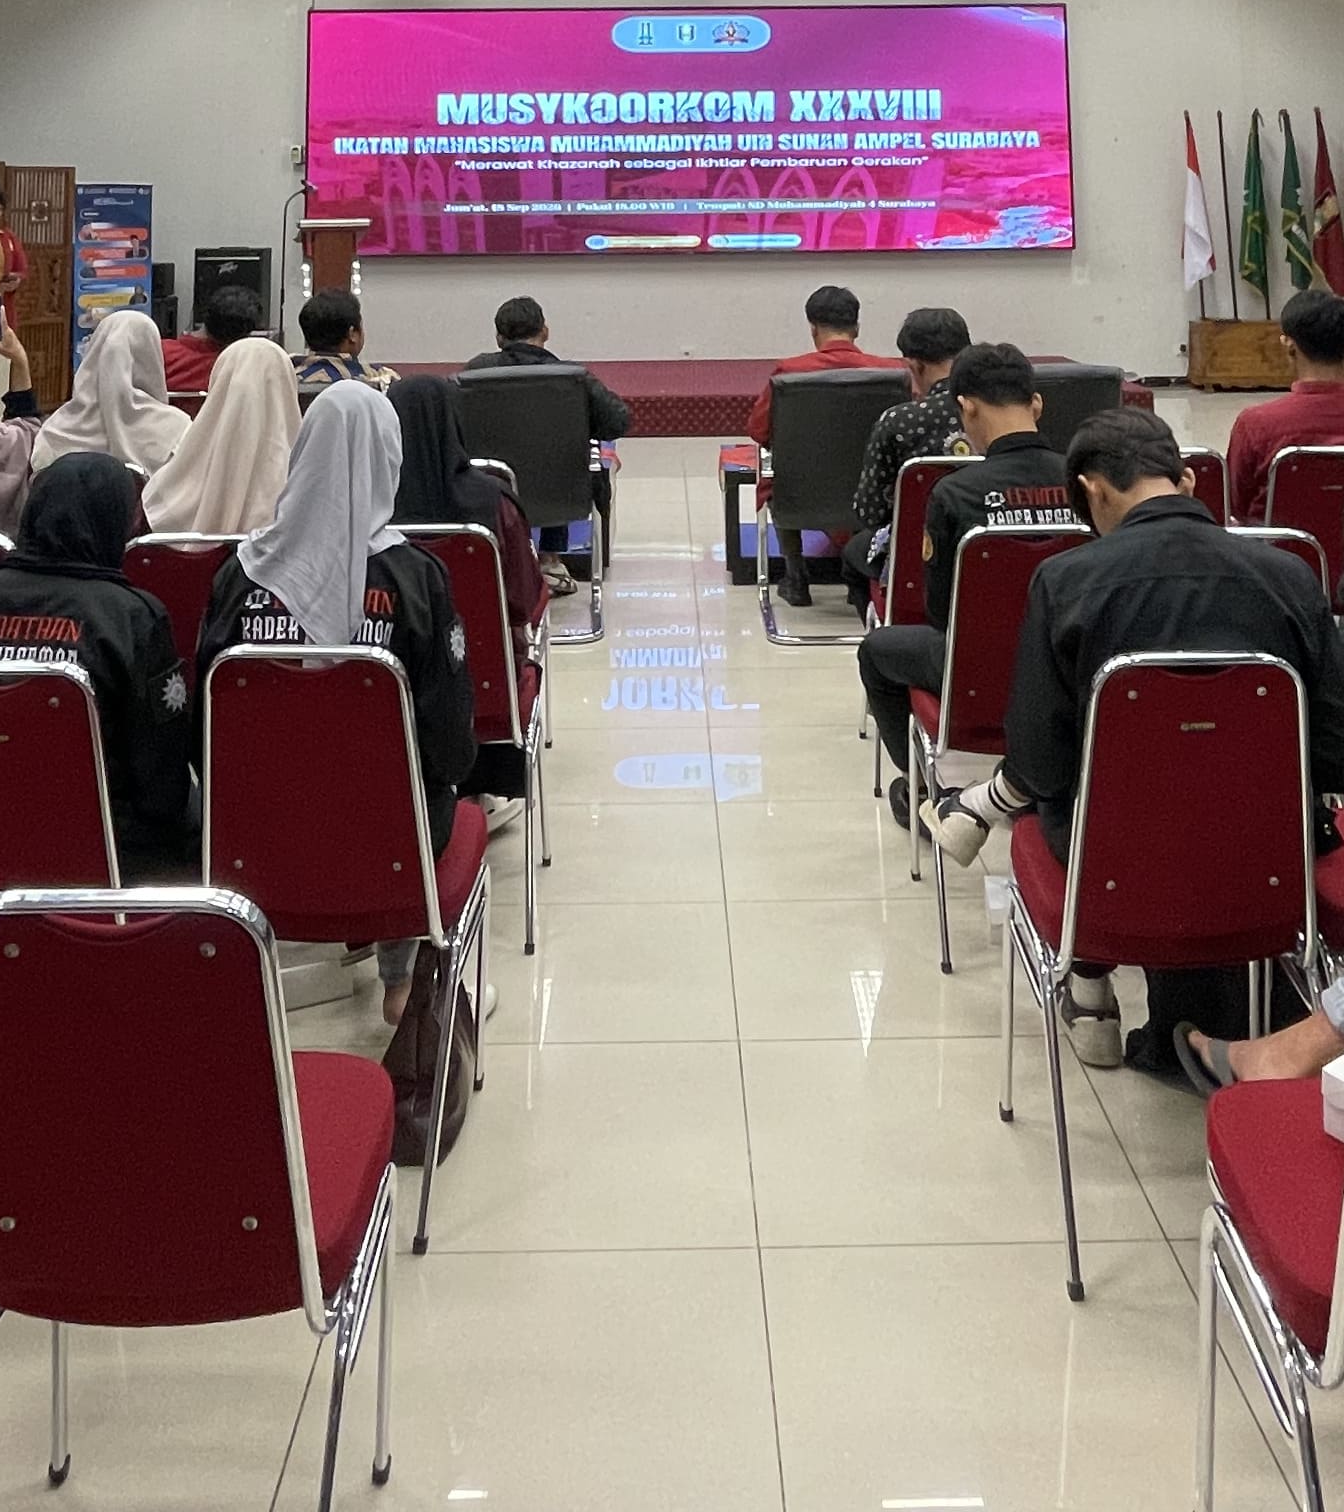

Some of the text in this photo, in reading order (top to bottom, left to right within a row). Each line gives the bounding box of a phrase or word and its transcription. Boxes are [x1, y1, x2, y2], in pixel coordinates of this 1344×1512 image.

[437, 89, 942, 125] MUSYKOORKOM XXXVIII
[334, 131, 1041, 155] IKATAN MAHASISWA MUHAMMADIYAH UIN SUNAN AMPEL SURABAYA
